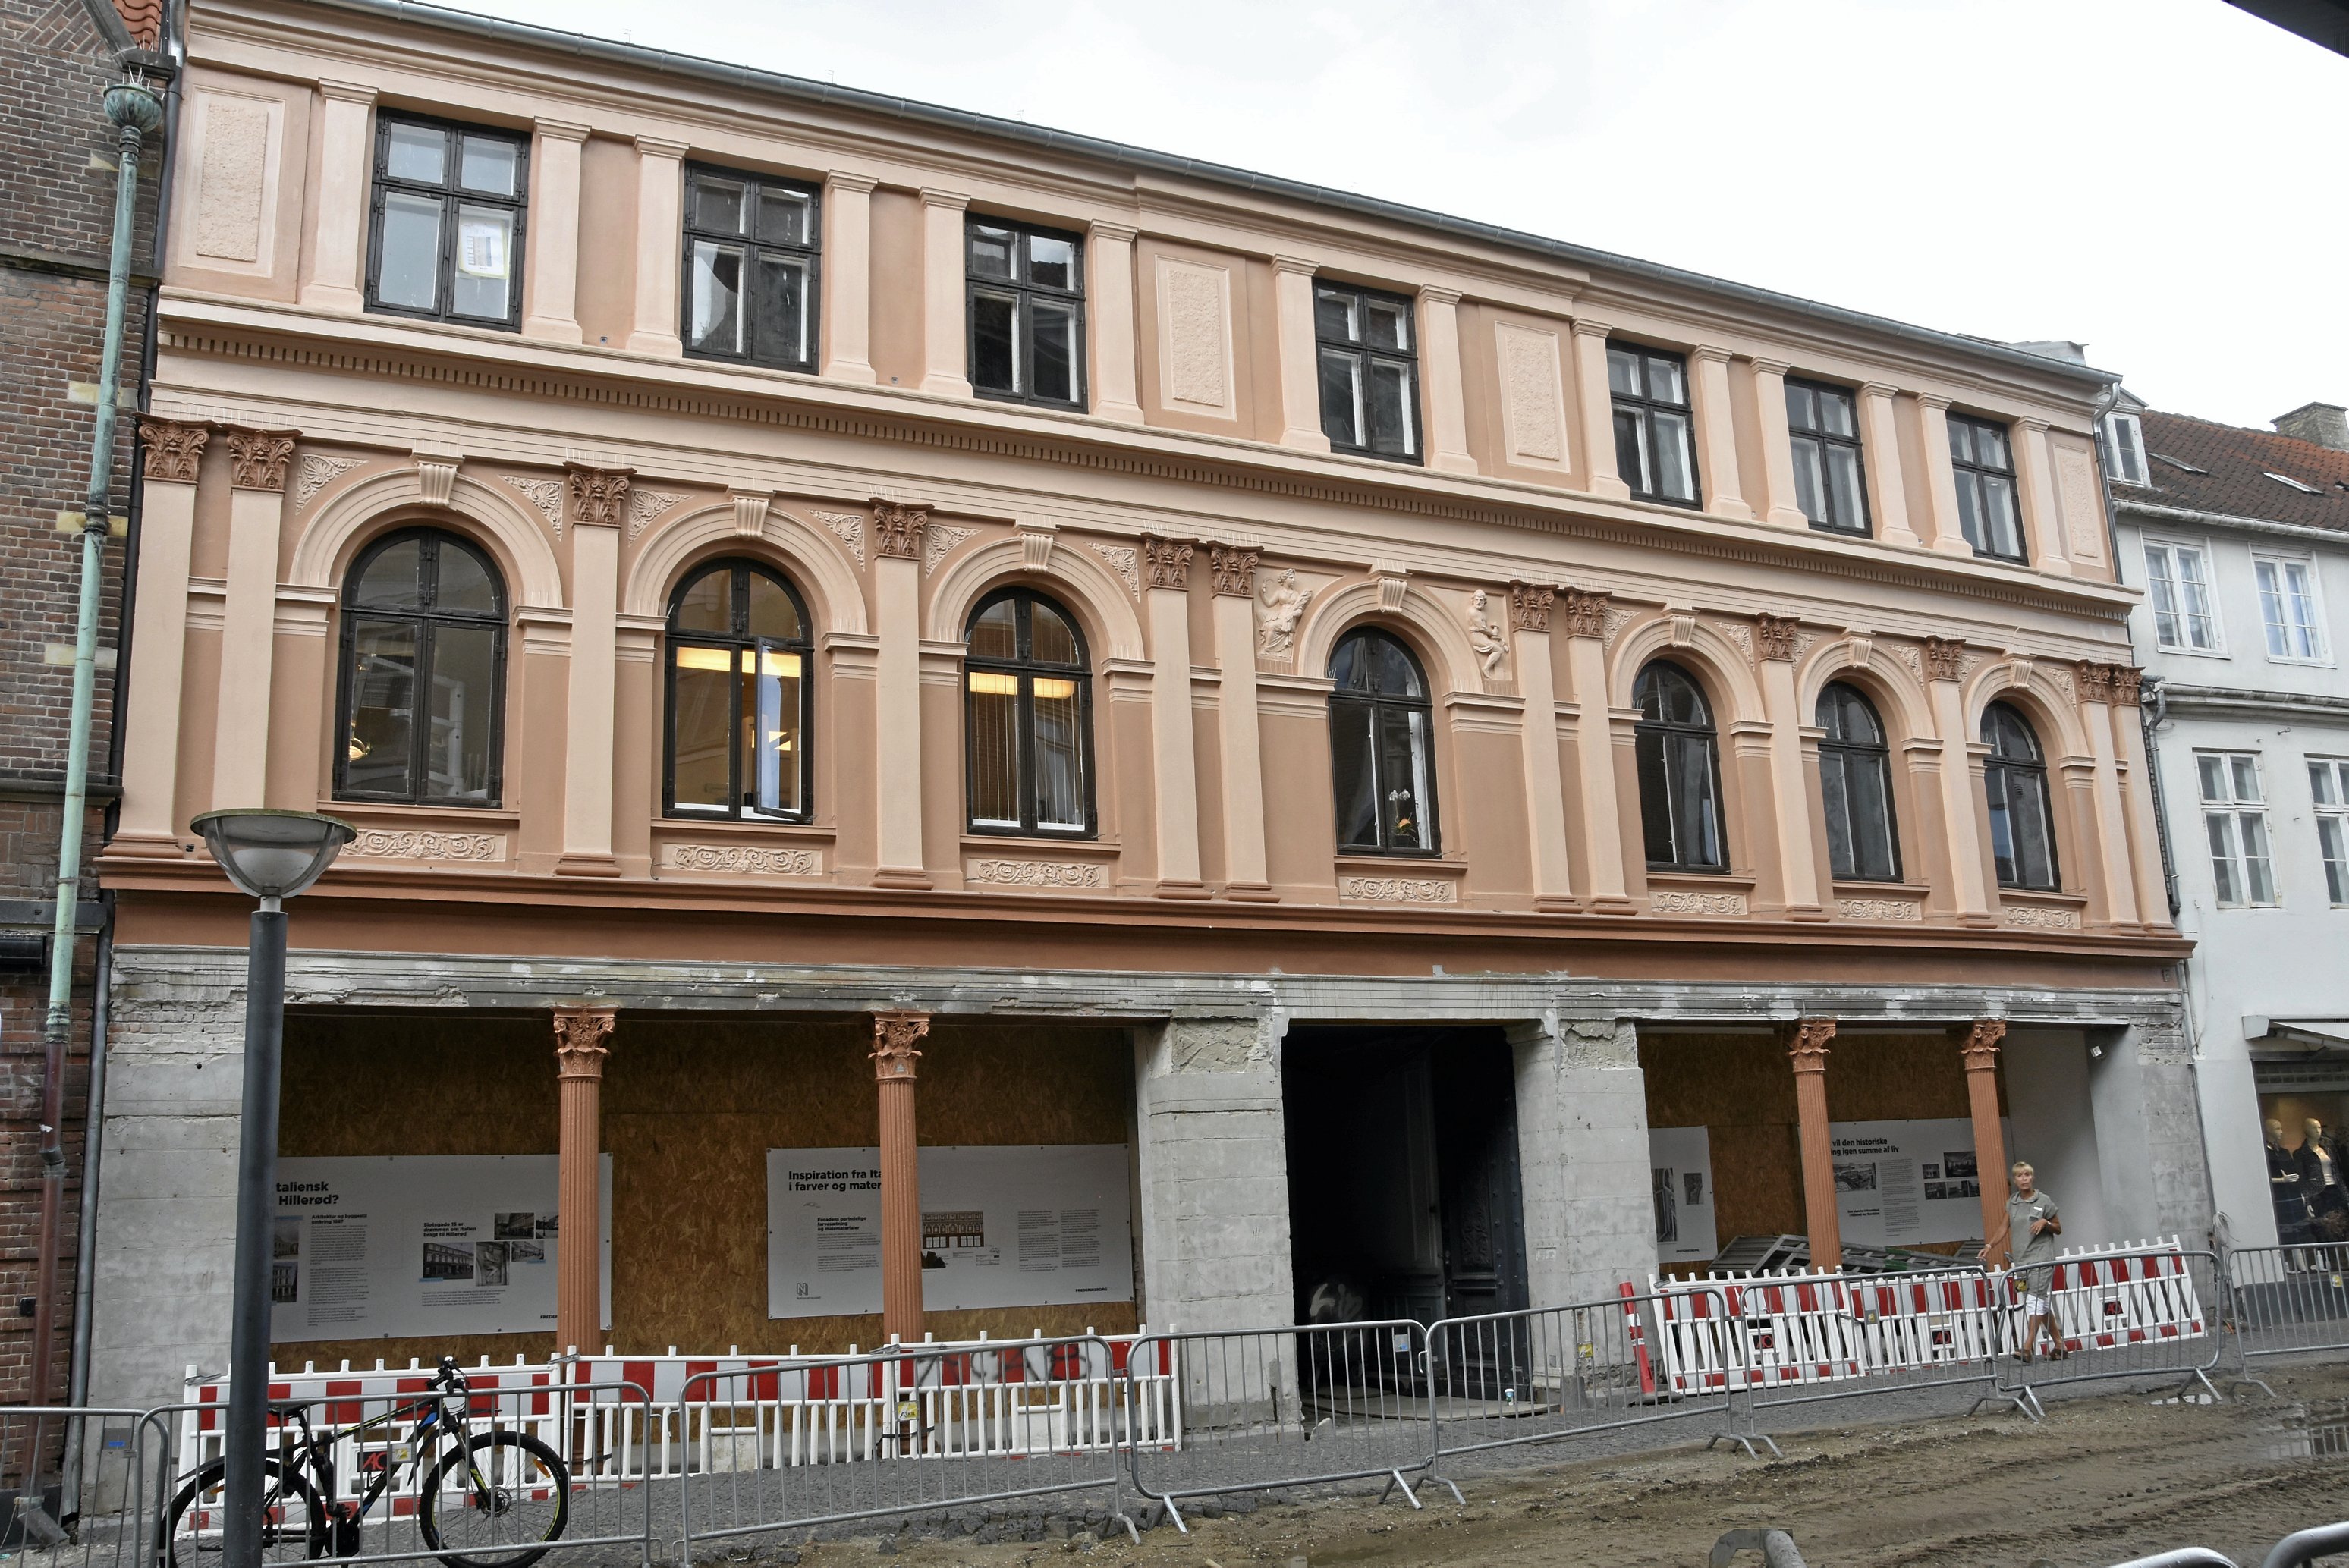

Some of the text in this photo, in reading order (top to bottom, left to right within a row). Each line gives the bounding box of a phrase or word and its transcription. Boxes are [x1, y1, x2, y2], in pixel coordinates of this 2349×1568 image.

[1842, 1148, 1857, 1156] igen
[788, 1170, 848, 1181] Inspiration
[851, 1170, 867, 1179] fra
[276, 1181, 329, 1192] taliensk
[788, 1182, 792, 1191] i
[795, 1181, 829, 1191] farver
[832, 1183, 846, 1192] og
[279, 1194, 339, 1205] Hillerød?
